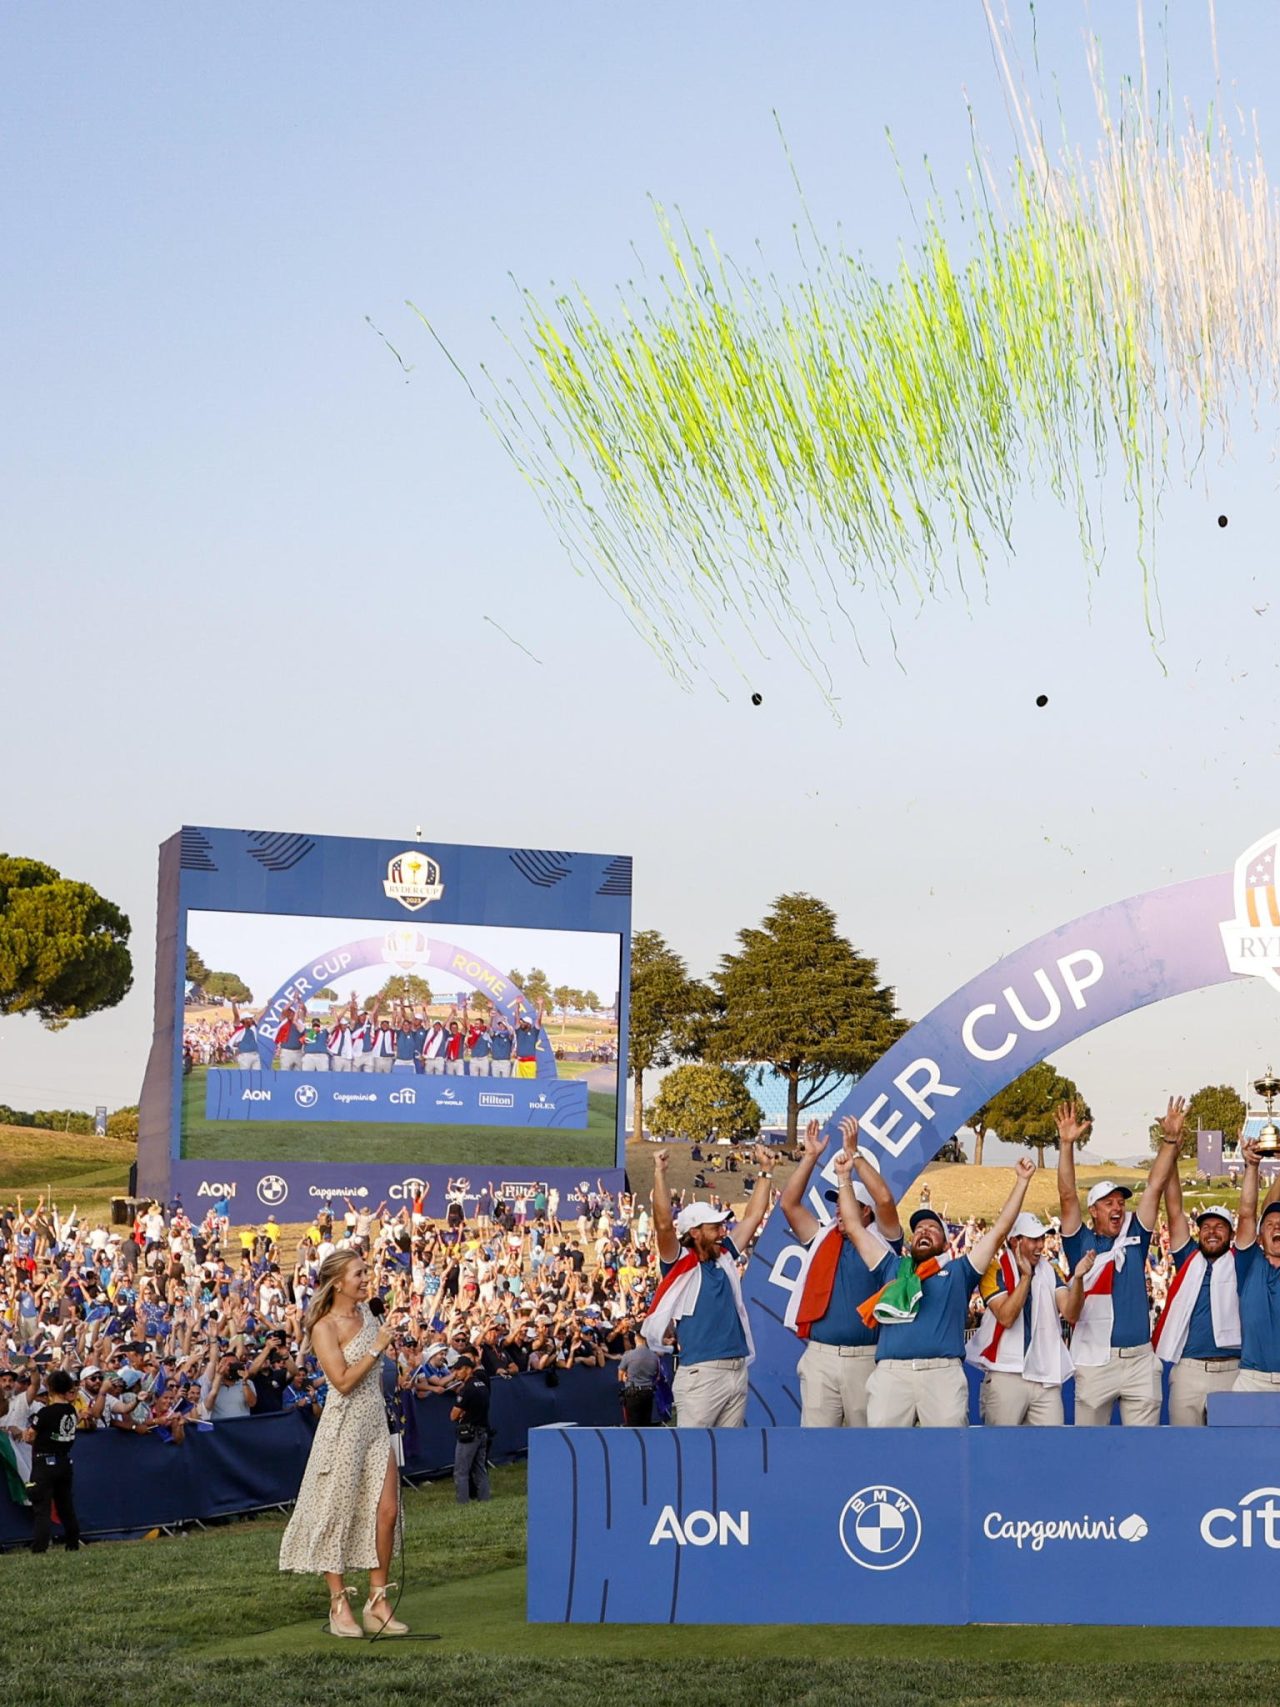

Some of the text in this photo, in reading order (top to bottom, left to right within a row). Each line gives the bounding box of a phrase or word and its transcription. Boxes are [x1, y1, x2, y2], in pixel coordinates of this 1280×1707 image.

[312, 952, 352, 981] CUP
[961, 949, 1105, 1062] CUP
[241, 1088, 271, 1101] AON
[389, 1090, 416, 1104] citi
[481, 1095, 511, 1105] Hilton
[197, 1181, 236, 1197] AON
[308, 1185, 358, 1200] Capgemini
[851, 1489, 910, 1514] BMW
[649, 1505, 749, 1546] AON
[983, 1511, 1118, 1551] Capgemini
